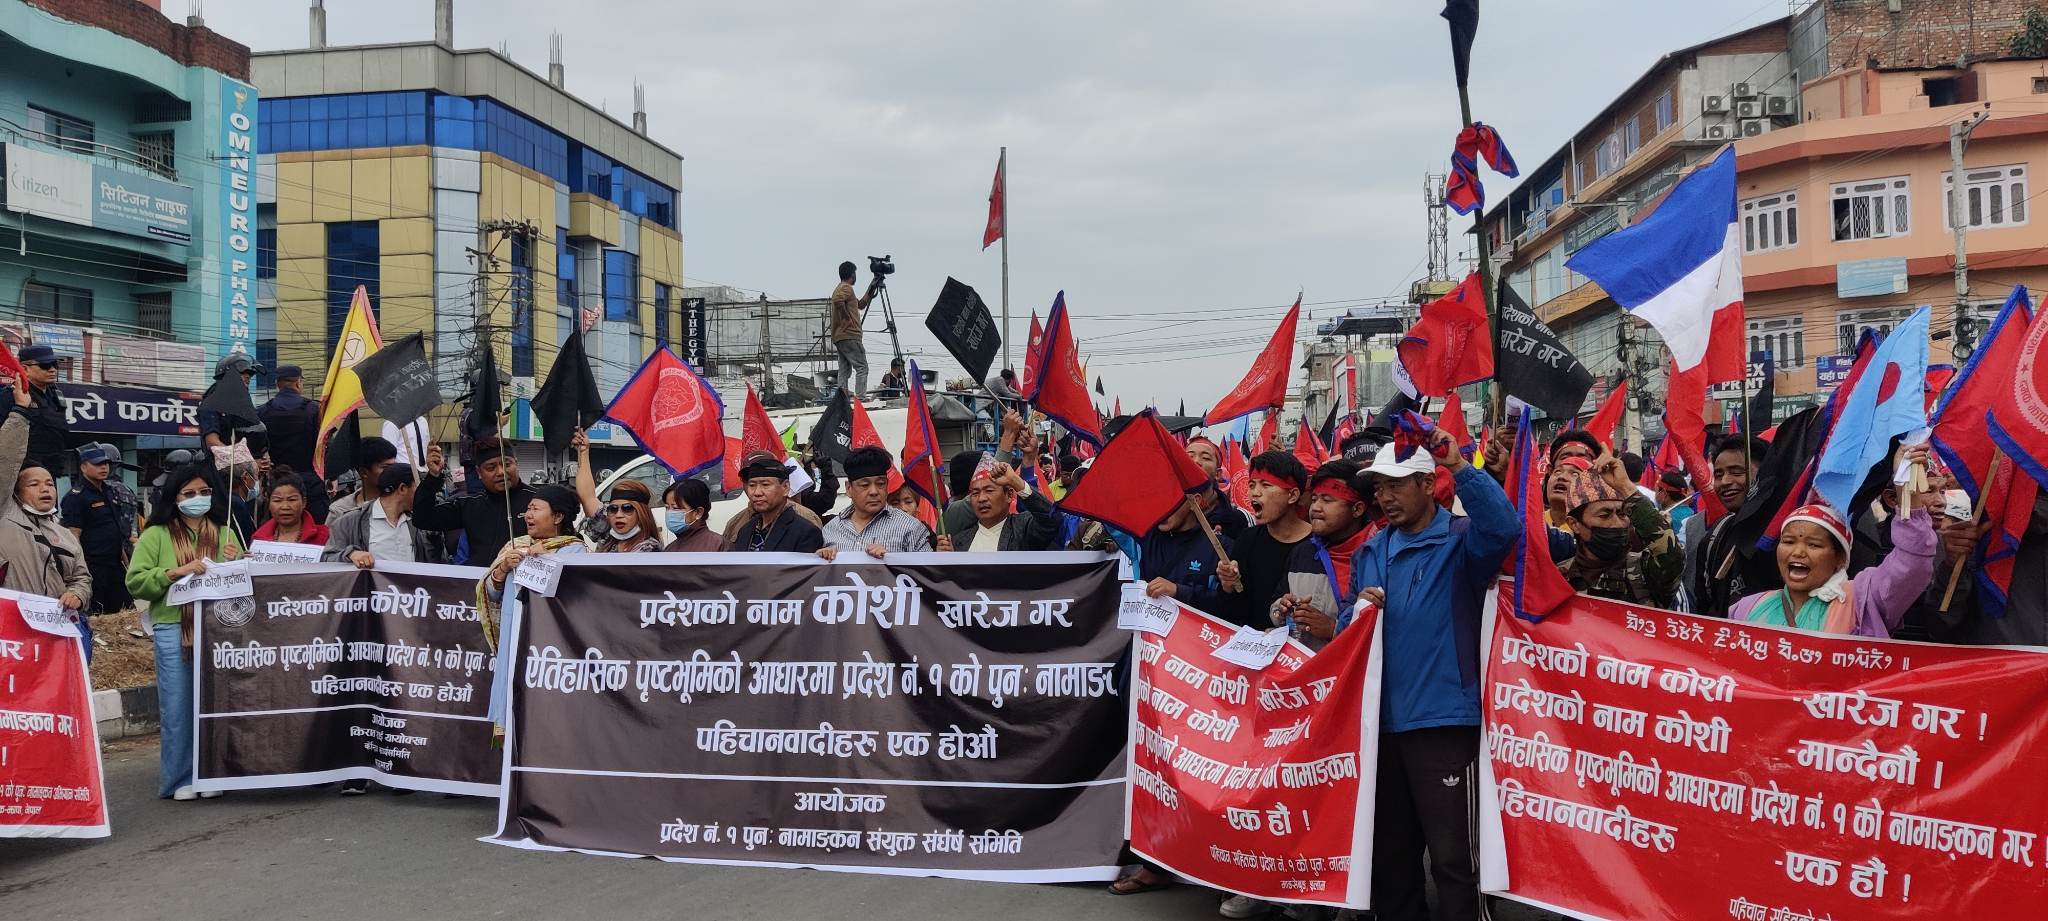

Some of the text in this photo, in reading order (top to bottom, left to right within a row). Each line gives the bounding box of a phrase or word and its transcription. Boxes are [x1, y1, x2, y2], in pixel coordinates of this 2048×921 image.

[100, 182, 150, 209] सिटिजन
[155, 197, 188, 217] लाइफ
[230, 259, 249, 354] PHARMA
[688, 309, 699, 366] THE GYM
[1537, 343, 1568, 369] गर
[1746, 363, 1766, 377] EX
[1721, 377, 1766, 391] PRNT
[204, 575, 222, 589] कोशी
[267, 594, 331, 619] प्रदेशको
[333, 597, 369, 614] नाम
[370, 584, 432, 619] कोशी
[639, 571, 1075, 630] प्रदेशको नाम कोशी खारेज गर
[212, 639, 278, 670] ऐतिहासिक
[385, 638, 417, 668] प्रदेश
[444, 644, 464, 670] को
[524, 645, 631, 694] ऐतिहासिक
[748, 660, 838, 697] आधारमा
[842, 650, 896, 700] प्रदेश
[900, 654, 923, 697] नं.
[928, 663, 943, 697] १
[949, 652, 982, 698] को
[1164, 653, 1210, 690] नाम
[1207, 670, 1250, 705] कोशी
[1501, 632, 1591, 679] प्रदेशको
[1596, 653, 1655, 690] नाम
[1658, 667, 1740, 704] कोशी
[1911, 702, 1966, 740] गर
[408, 682, 435, 699] एक
[0, 709, 54, 736] माङ्कन
[371, 712, 408, 729] आयोजक
[1151, 686, 1189, 720] नाम
[1186, 708, 1241, 743] कोशी
[1493, 677, 1587, 726] प्रदेशको
[1592, 701, 1649, 739] नाम
[1654, 709, 1733, 755] कोशी
[886, 730, 932, 758] एक
[1172, 746, 1230, 785] आधारमा
[1281, 751, 1358, 788] नामाङ्कन
[794, 787, 888, 814] आयोजक
[1487, 721, 2037, 869] ऐतिहासिक पृष्ठभूमिको आधारमा प्रदेश नं. १ को नामाङ्कन गर
[660, 817, 700, 845] प्रदेश
[704, 820, 721, 844] नं.
[726, 826, 738, 846] १
[778, 828, 862, 853] नामाङ्कन
[866, 827, 918, 857] संयुक्त
[969, 828, 1024, 855] समिति
[1295, 852, 1310, 873] को
